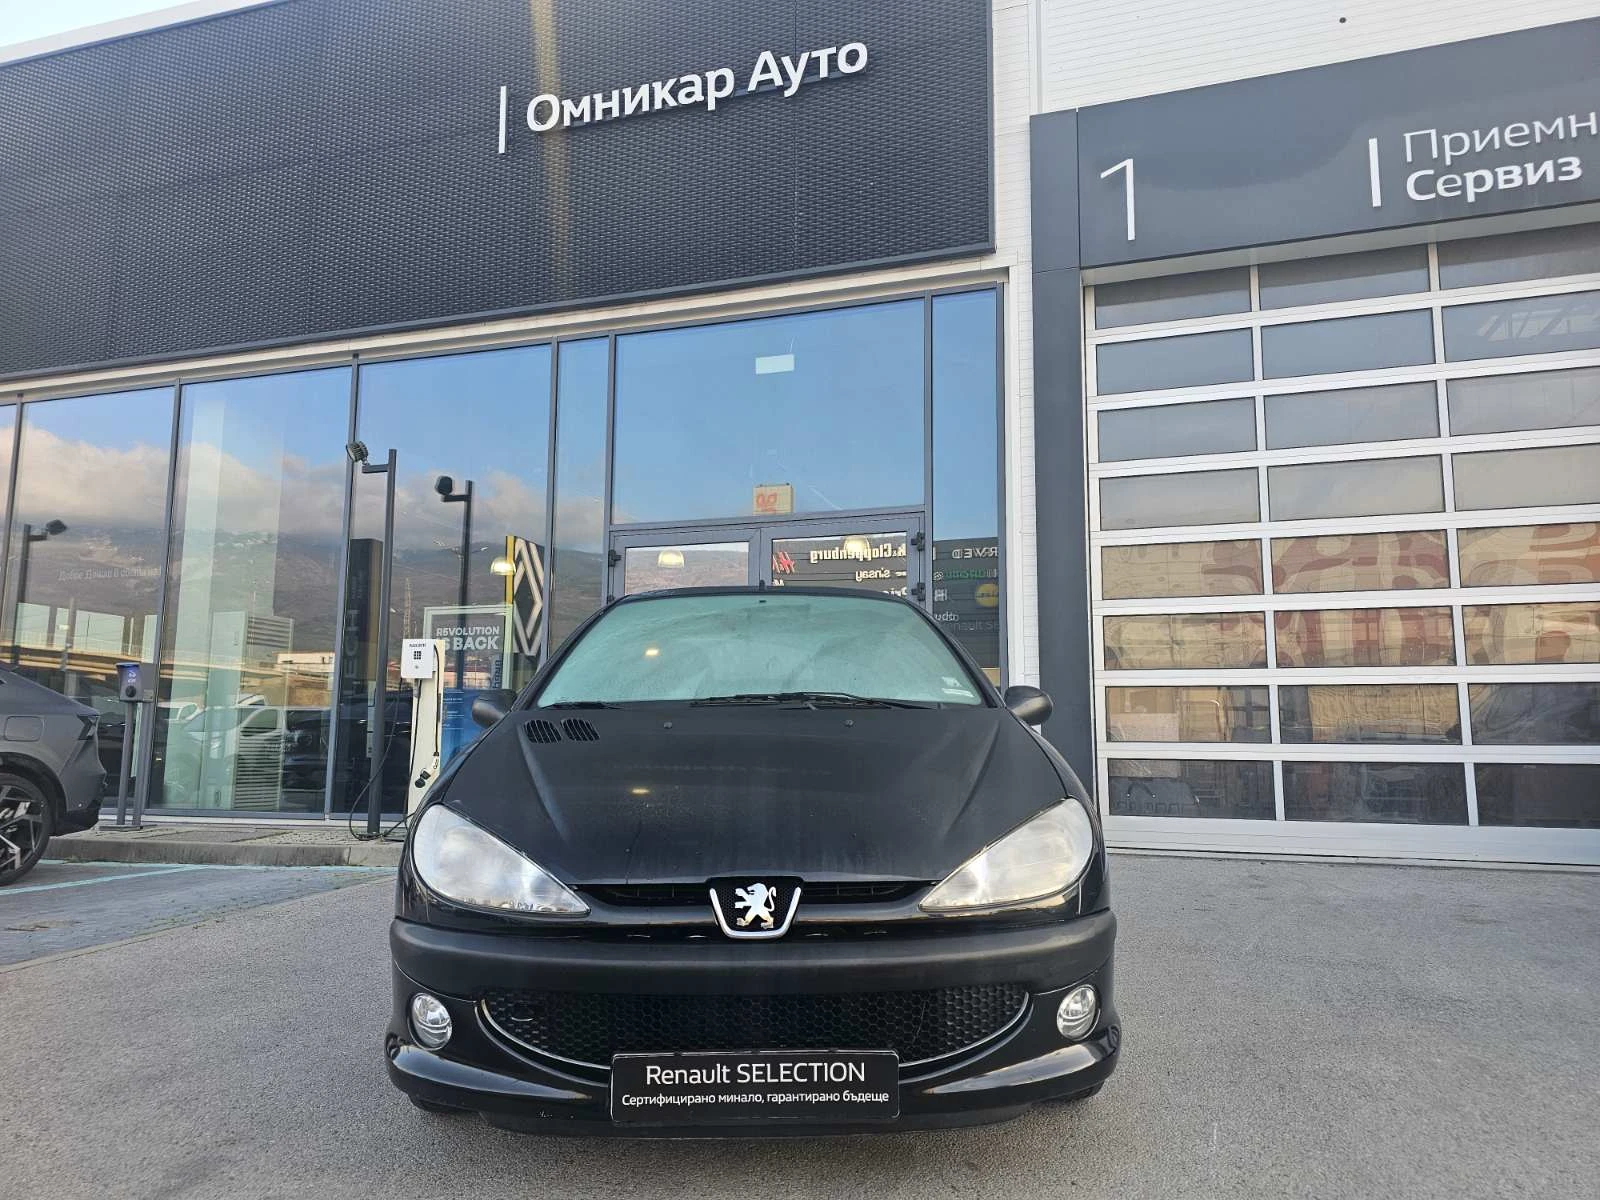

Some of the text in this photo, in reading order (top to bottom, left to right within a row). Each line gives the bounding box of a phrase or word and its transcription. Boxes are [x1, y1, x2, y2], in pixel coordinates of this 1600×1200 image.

[526, 42, 869, 132] Омникар Ауто
[1402, 111, 1599, 166] Приемн
[1405, 156, 1583, 203] Сервиз
[1100, 158, 1136, 241] 1
[436, 626, 500, 637] R5VOLUTION
[453, 636, 500, 651] BACK
[645, 1061, 866, 1085] Renault SELECTION
[621, 1090, 889, 1107] Сертифицирано минало, гарантирано бъдеще
